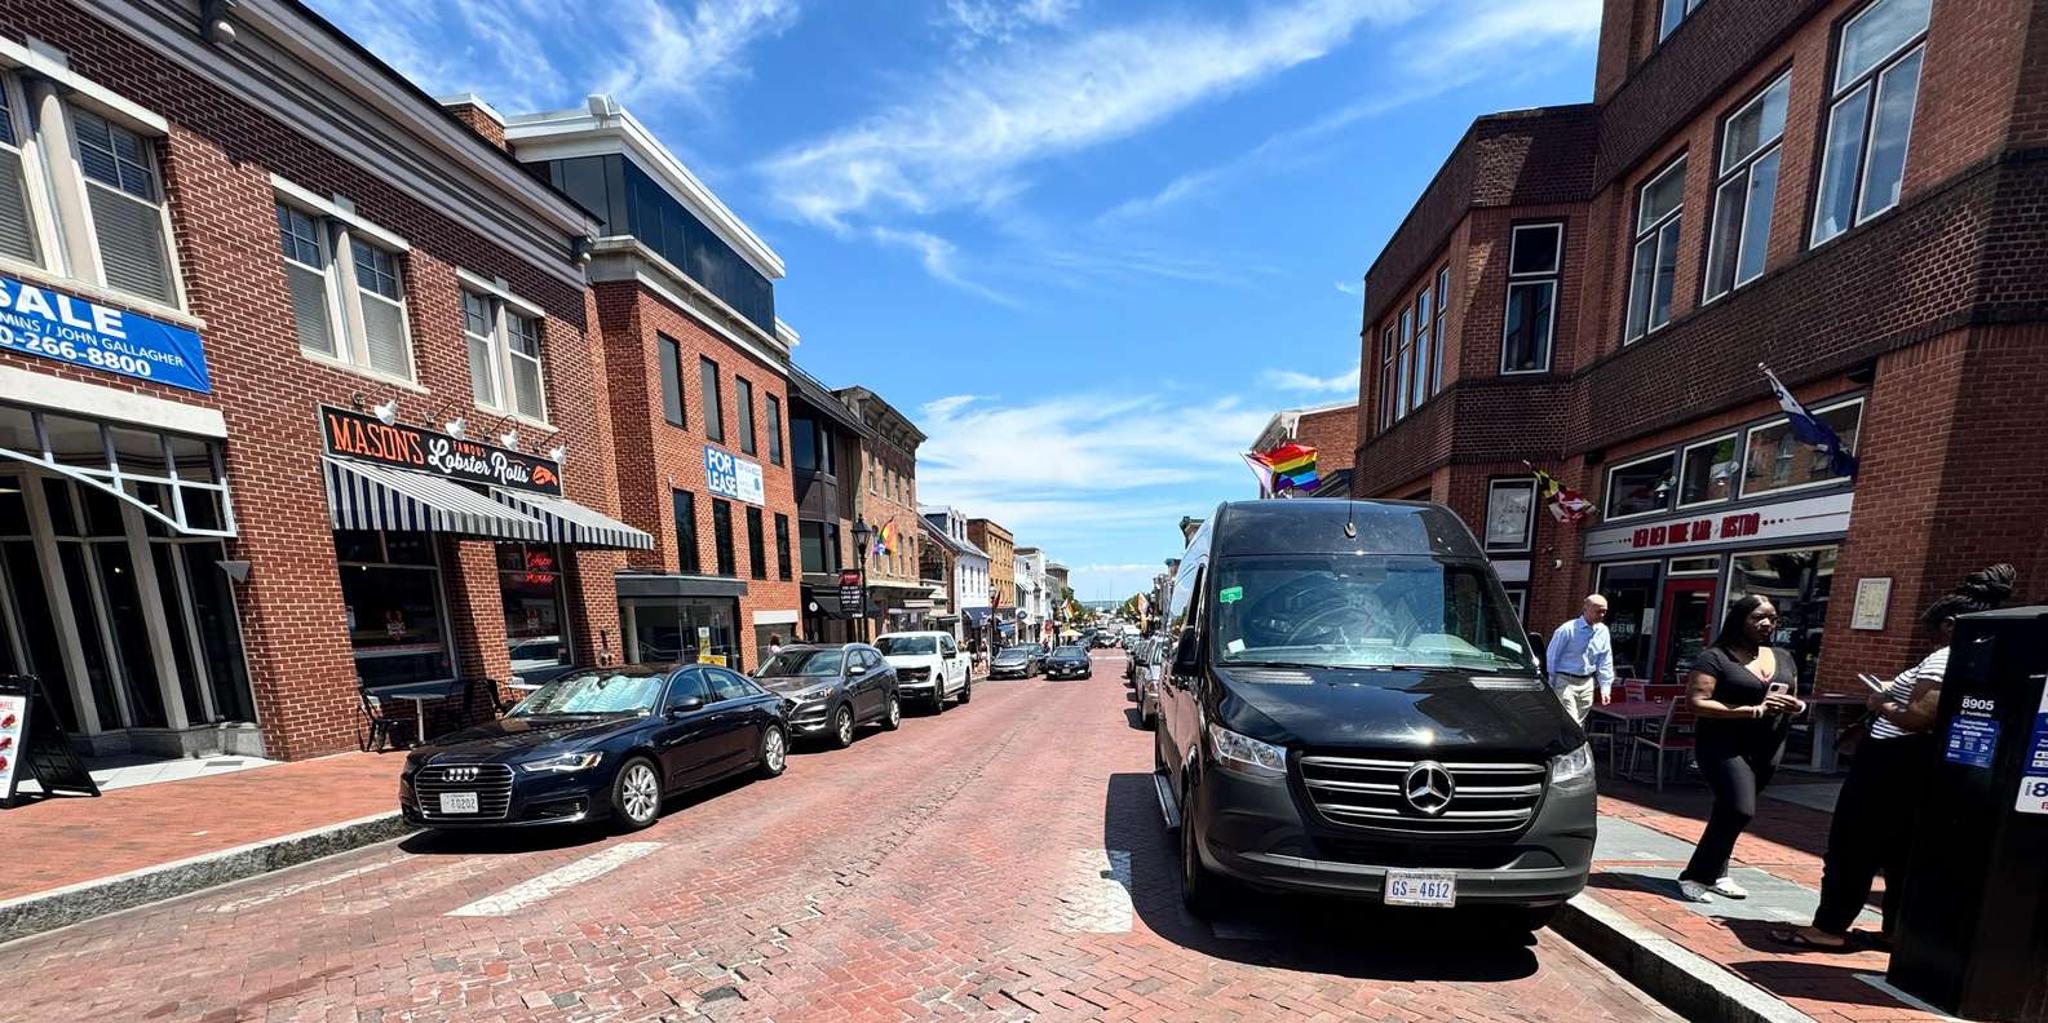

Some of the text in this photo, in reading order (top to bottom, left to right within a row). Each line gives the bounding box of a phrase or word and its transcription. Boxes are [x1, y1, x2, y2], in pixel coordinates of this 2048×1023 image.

[0, 326, 151, 377] 0-266-8800
[56, 326, 98, 347] JOHN
[102, 337, 184, 367] GALLAGHER
[328, 413, 425, 465] MASON'S
[452, 441, 487, 459] FAMOUS
[427, 438, 529, 485] Lobster Rolls
[708, 448, 733, 476] FOR
[708, 469, 737, 496] LEASE
[1720, 513, 1760, 538] BISTRO
[1962, 698, 1995, 710] 8905
[1420, 882, 1449, 899] 4612
